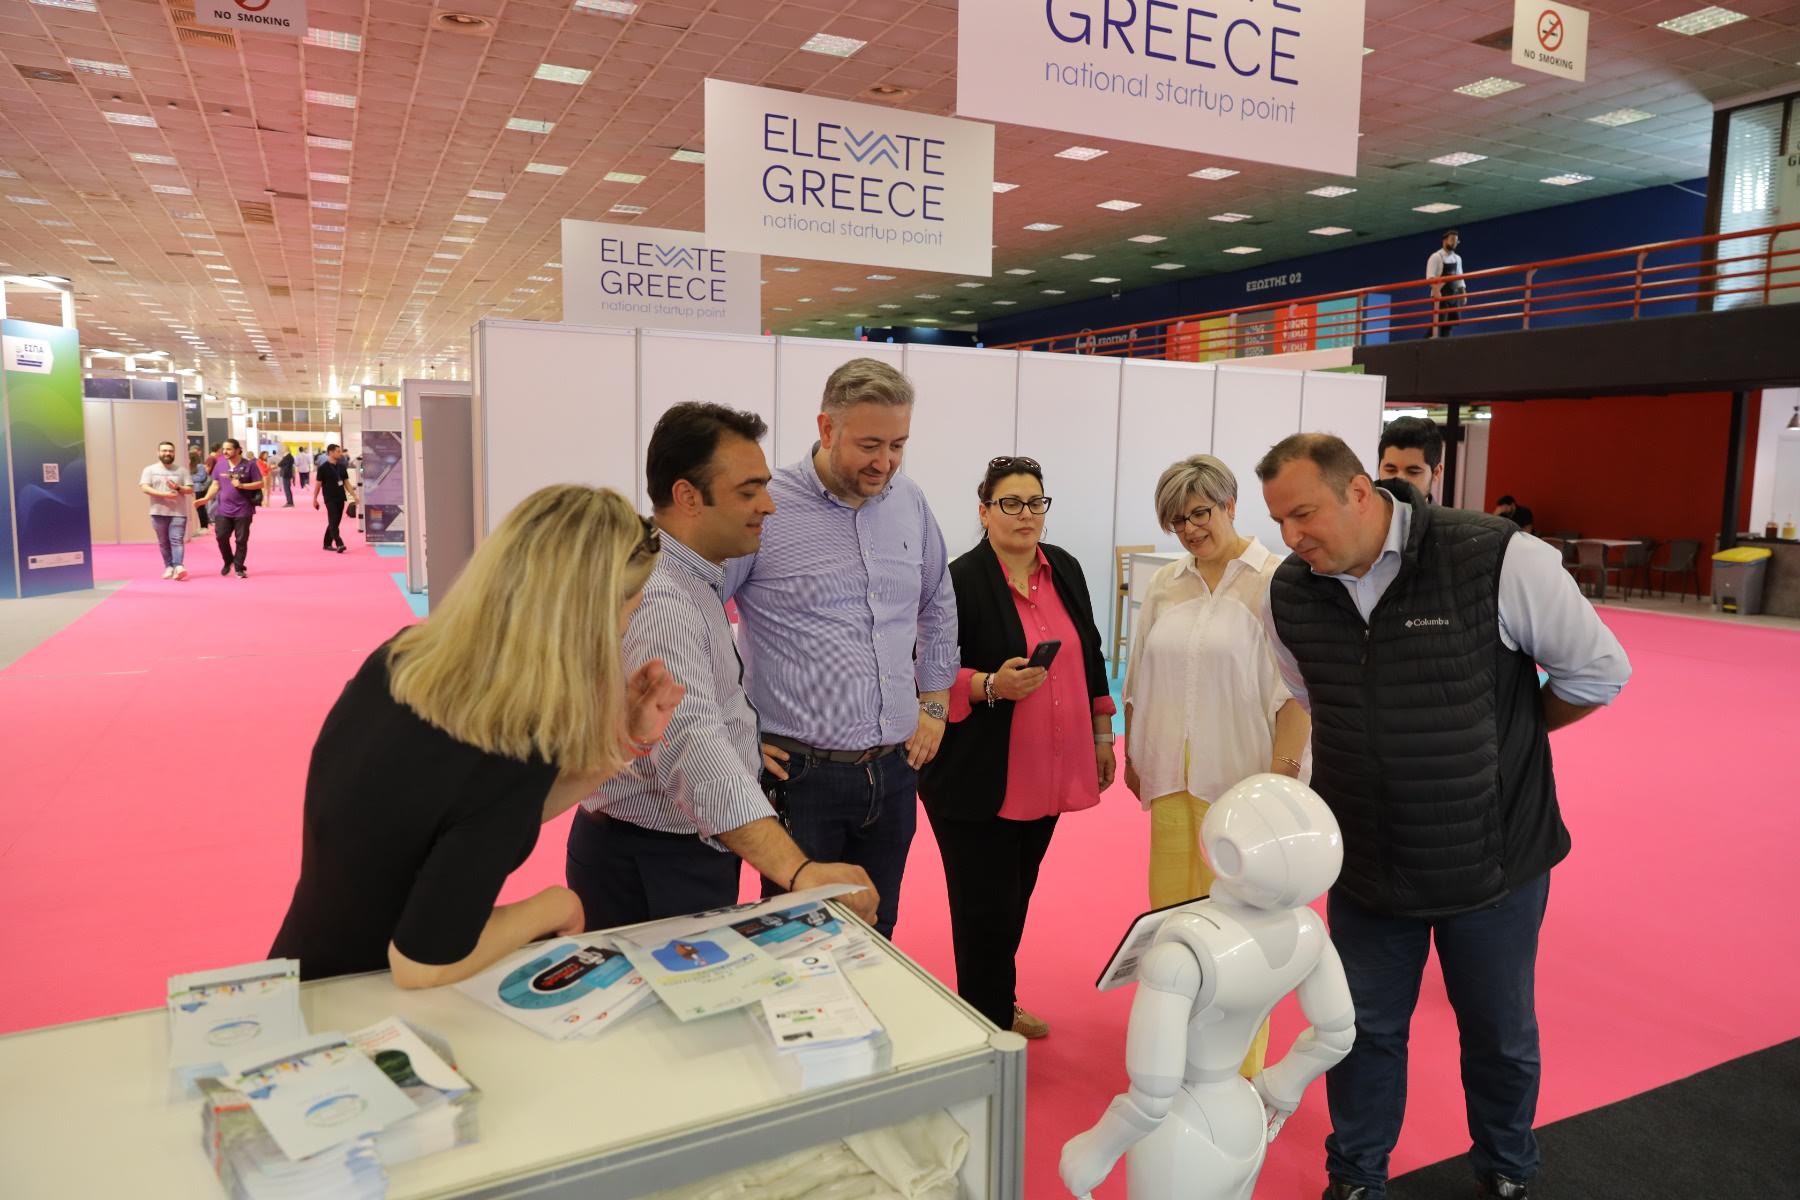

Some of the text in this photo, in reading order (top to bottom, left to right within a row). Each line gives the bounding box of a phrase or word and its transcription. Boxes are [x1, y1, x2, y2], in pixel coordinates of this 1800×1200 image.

[214, 10, 290, 27] NO SMOKING
[1046, 0, 1300, 85] GREECE
[1523, 48, 1573, 70] NO SMOKING
[1046, 61, 1296, 124] national startup point
[763, 112, 946, 176] ELEVATE
[762, 164, 945, 222] GREECE
[762, 211, 944, 247] national startup point
[601, 237, 727, 274] ELEVATE
[600, 269, 727, 303] GREECE
[1288, 272, 1302, 285] 02
[601, 299, 726, 320] national startup point
[1413, 617, 1449, 626] Columba
